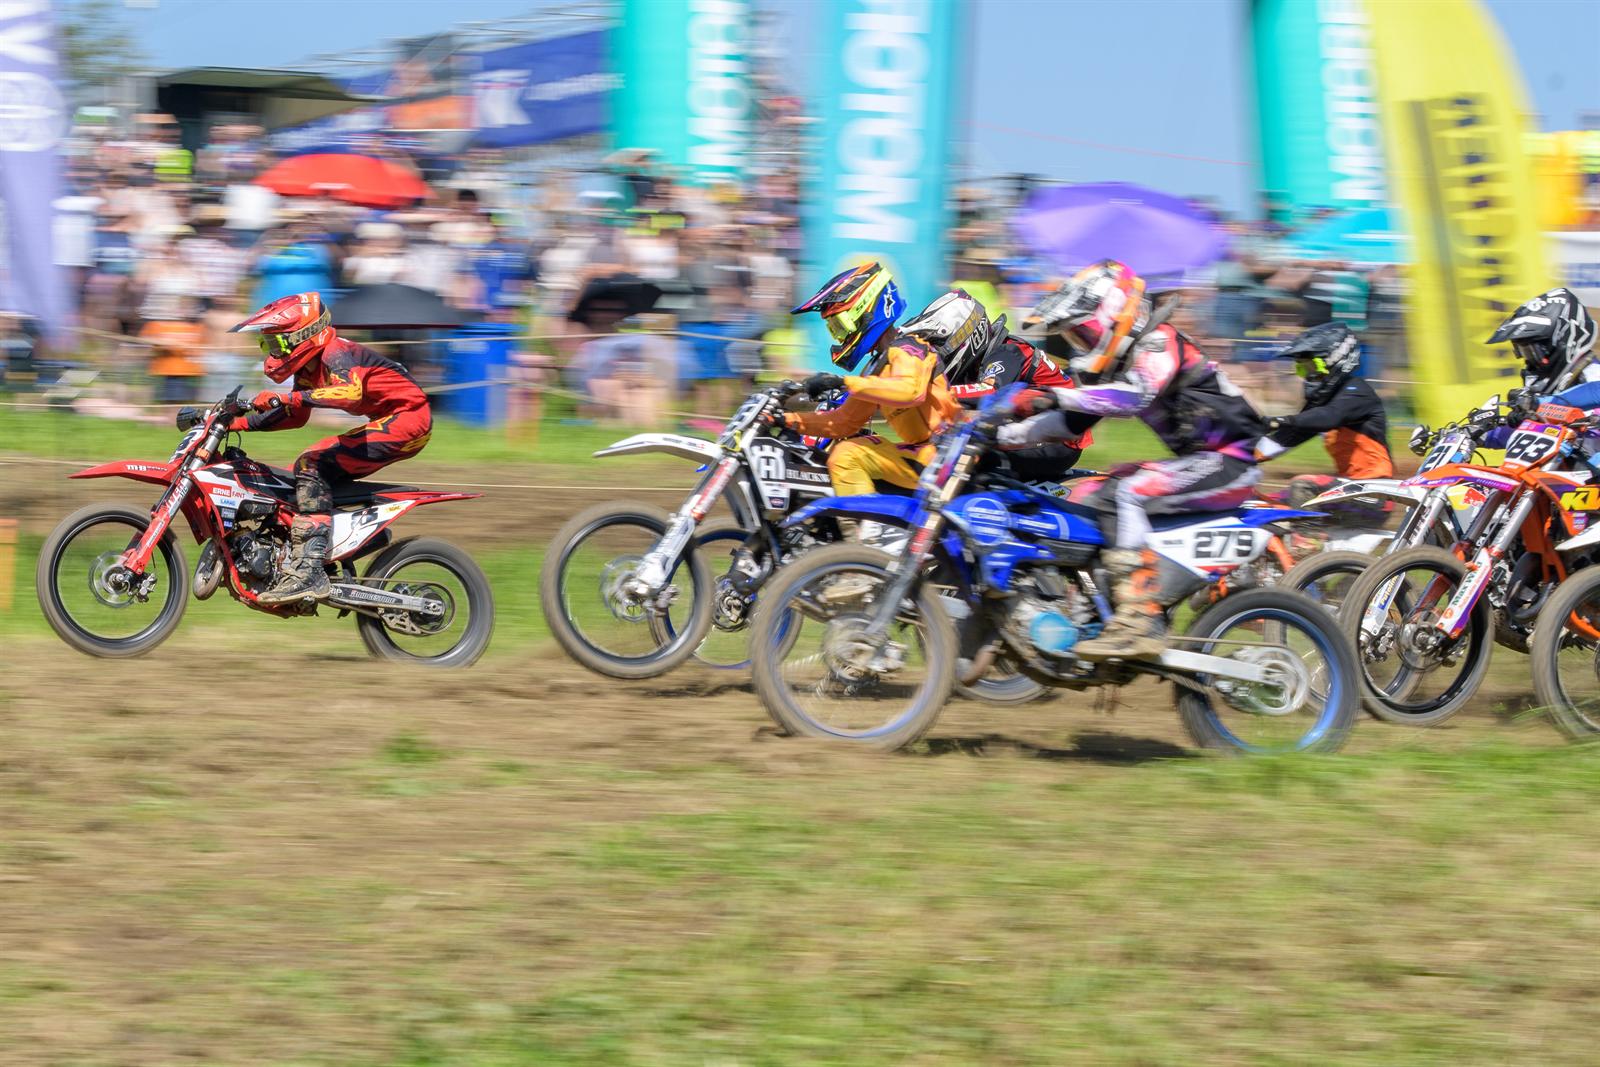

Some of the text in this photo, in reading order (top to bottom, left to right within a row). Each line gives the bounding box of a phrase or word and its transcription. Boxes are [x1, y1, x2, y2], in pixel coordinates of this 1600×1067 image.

[1505, 432, 1555, 463] 183
[1560, 487, 1600, 511] KT
[1194, 530, 1254, 559] 279
